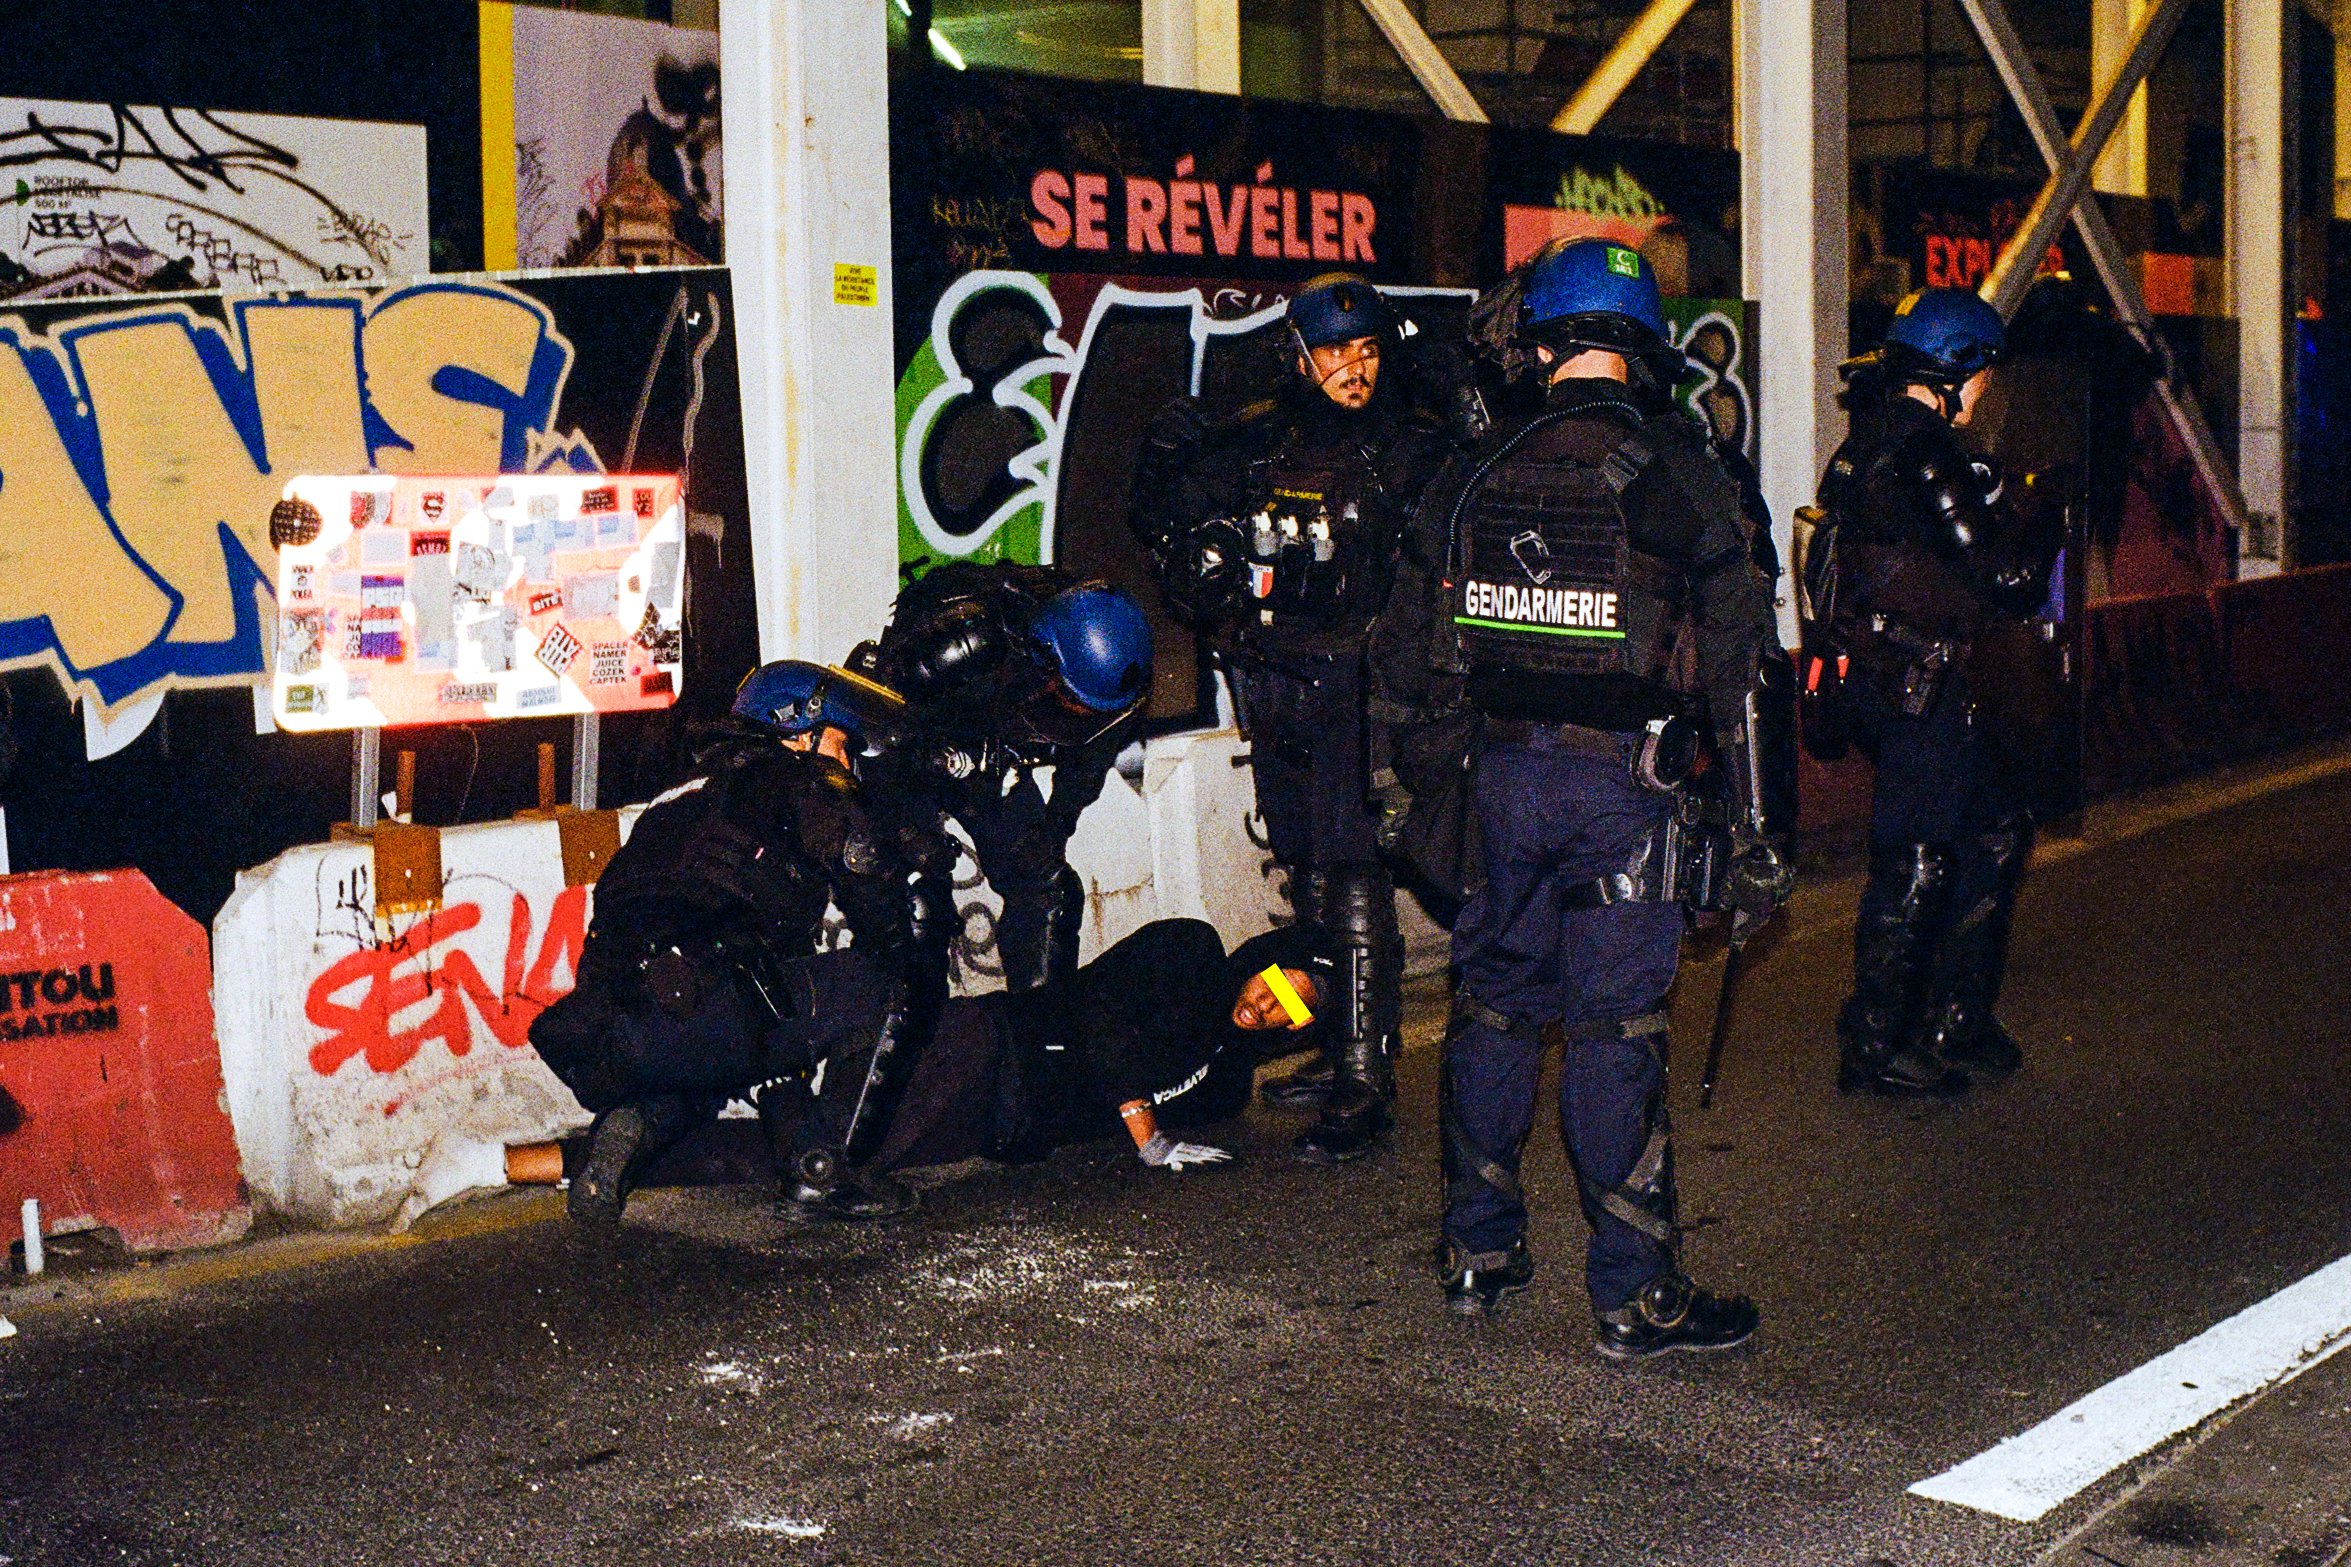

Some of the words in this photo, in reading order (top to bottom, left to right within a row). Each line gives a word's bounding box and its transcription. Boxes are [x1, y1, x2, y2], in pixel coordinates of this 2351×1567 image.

[1030, 168, 1109, 251] SE
[1125, 153, 1377, 263] RÉVÉLER
[1465, 580, 1618, 628] GENDARMERIE
